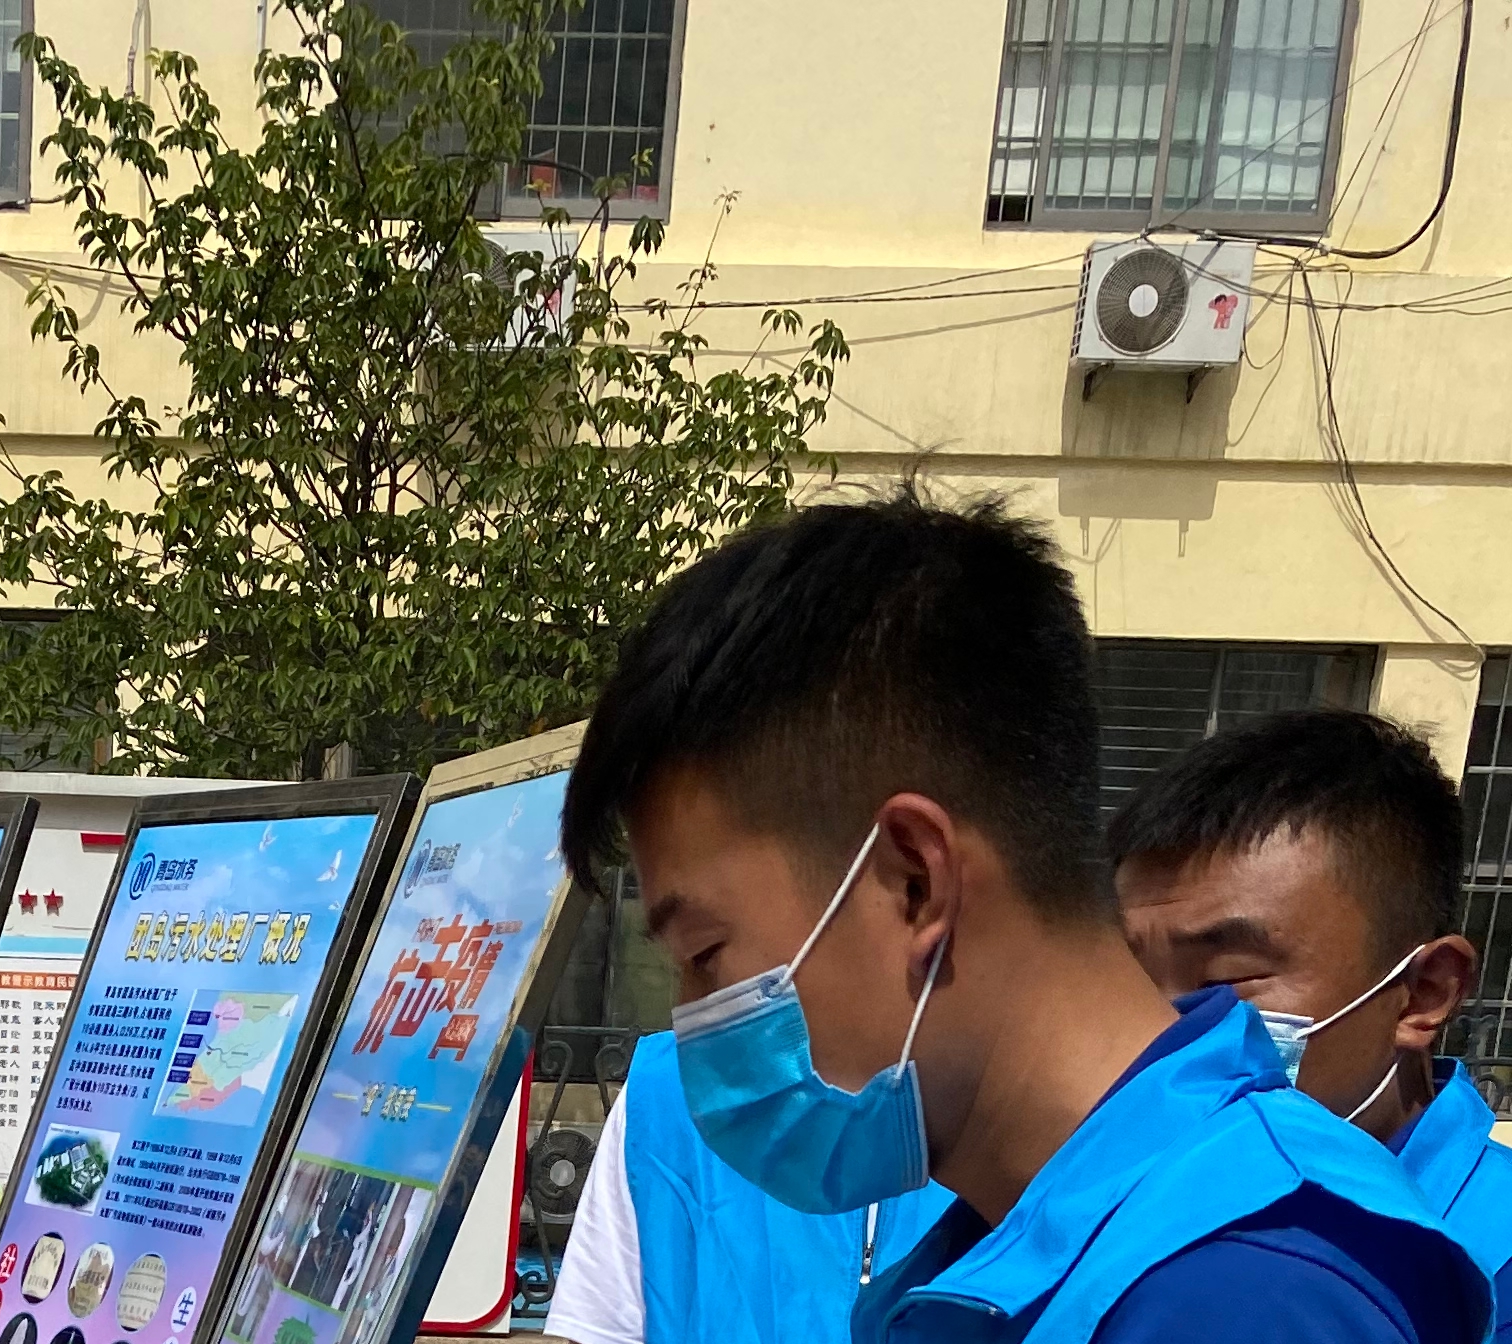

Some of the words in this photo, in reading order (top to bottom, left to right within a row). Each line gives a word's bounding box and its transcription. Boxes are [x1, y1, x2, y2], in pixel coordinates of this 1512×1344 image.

[154, 858, 198, 881] 青岛水务
[125, 910, 312, 965] 团岛污水处理厂概况
